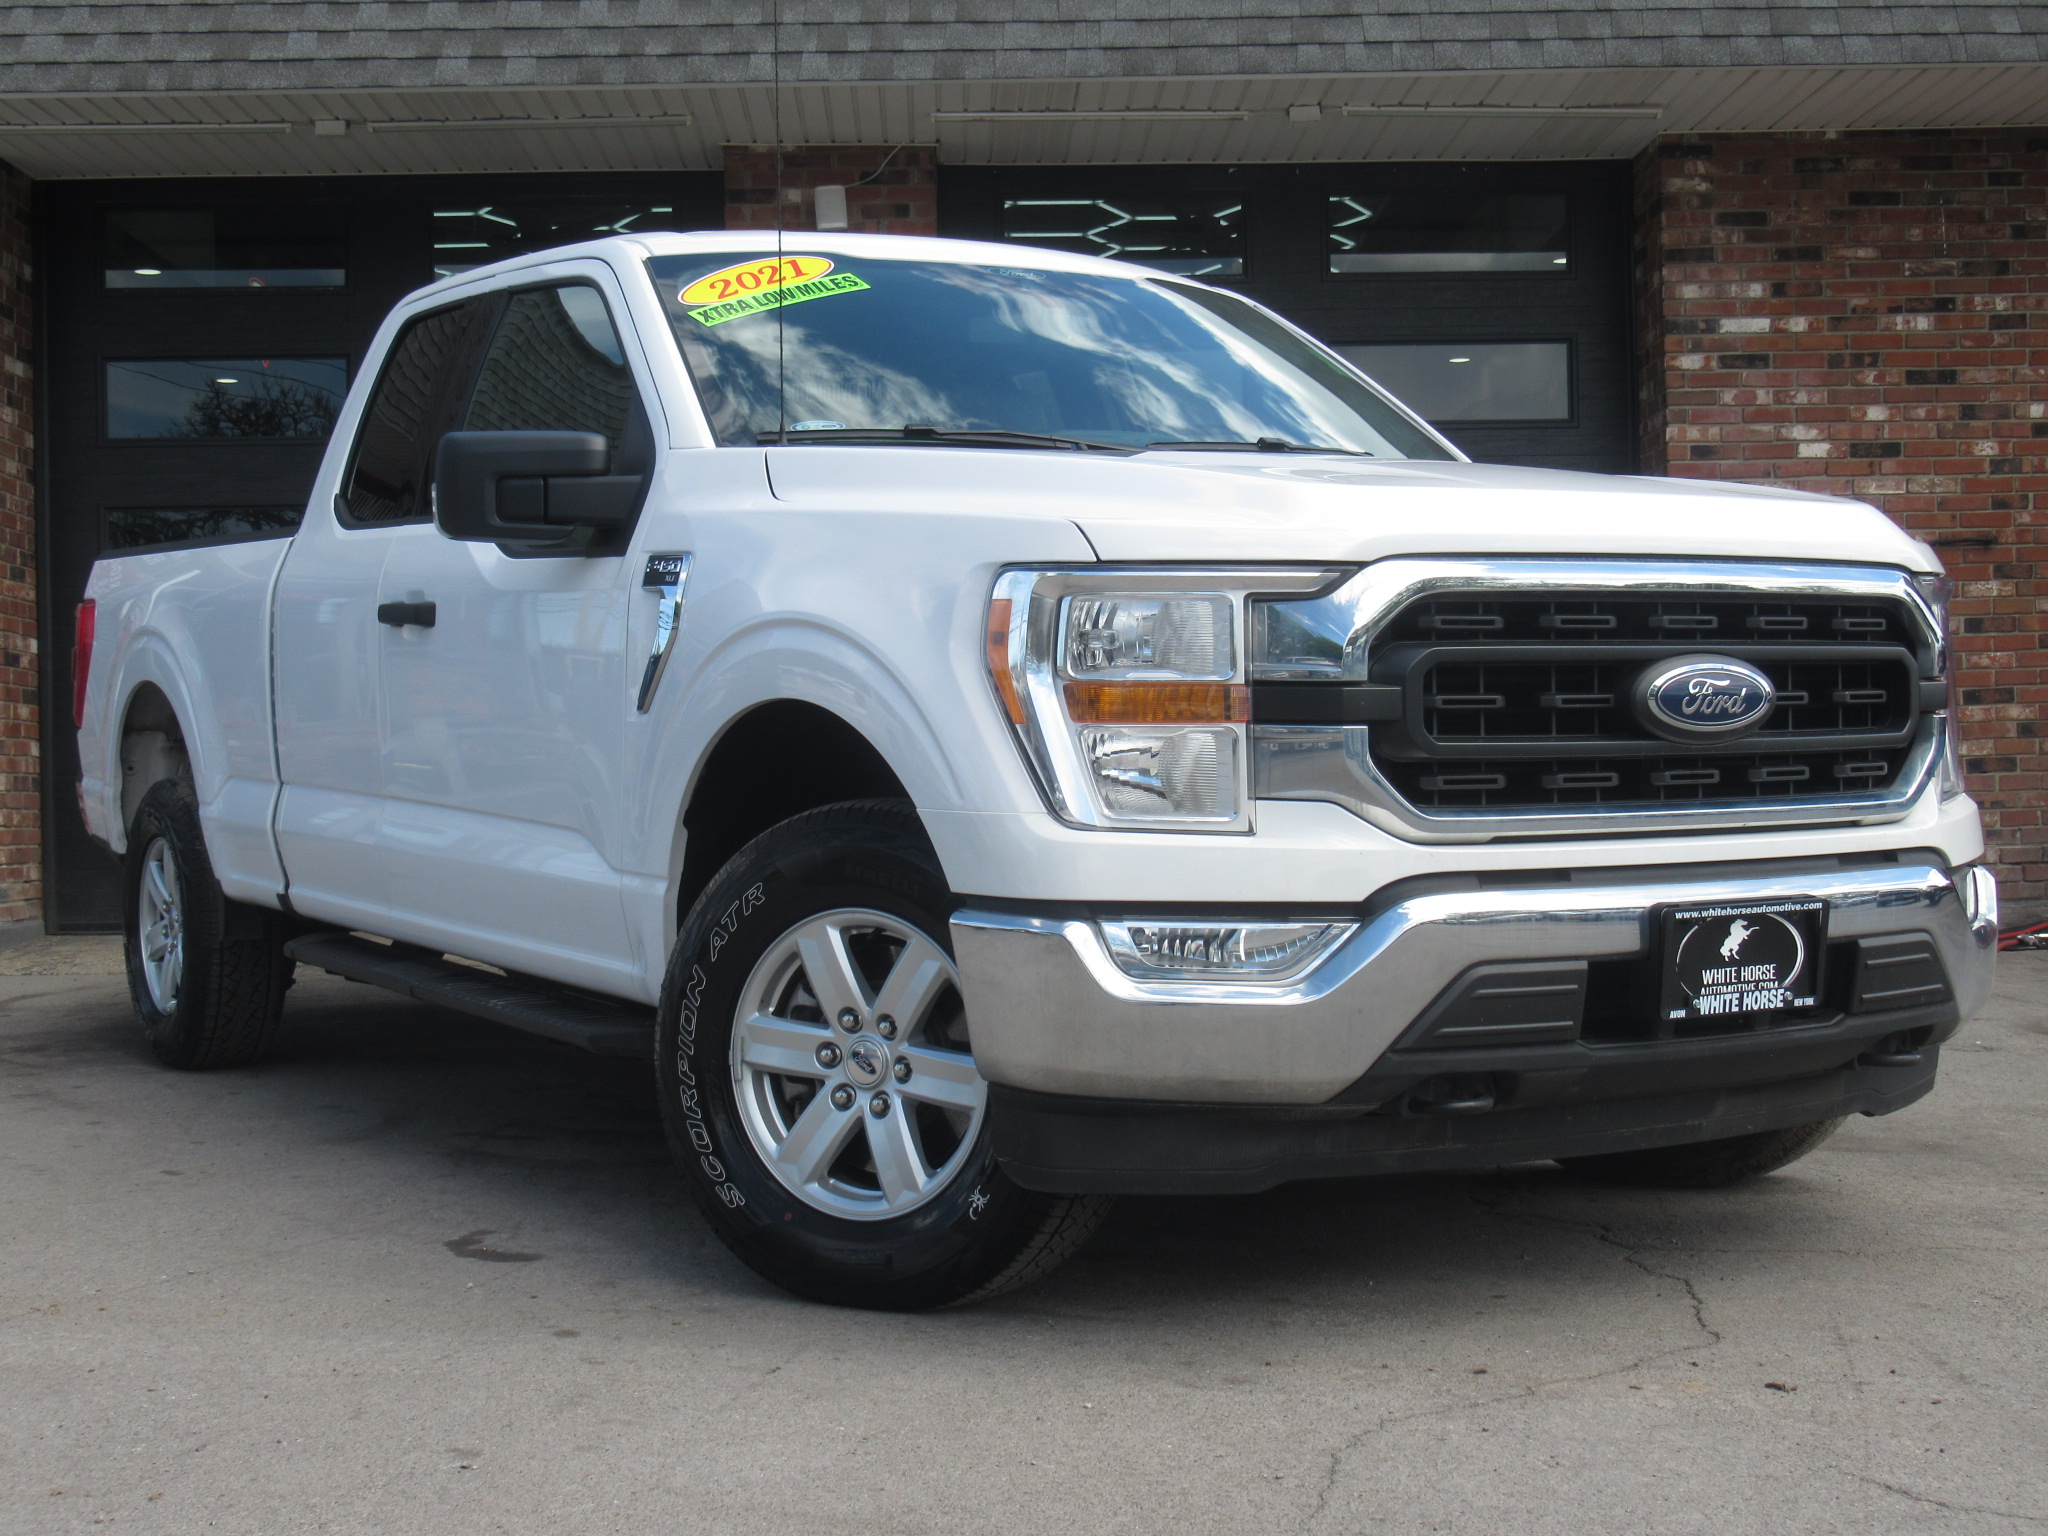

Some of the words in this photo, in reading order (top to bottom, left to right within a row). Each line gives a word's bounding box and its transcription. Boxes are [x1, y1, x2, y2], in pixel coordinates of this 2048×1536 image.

[708, 259, 811, 300] 2021
[697, 299, 755, 323] XTRA
[752, 287, 796, 307] LOW
[799, 275, 860, 297] MILES
[1681, 677, 1747, 714] Ford
[709, 882, 766, 962] ATR
[1674, 902, 1823, 919] www.whitehorseautomotive.com
[1701, 967, 1738, 985] WHITE
[1740, 964, 1777, 982] HORSE
[1669, 1009, 1686, 1019] AVON
[1699, 992, 1740, 1015] WHITE
[1742, 988, 1785, 1011] HORSE
[854, 1054, 873, 1072] Ford
[677, 964, 746, 1209] SCORPION
